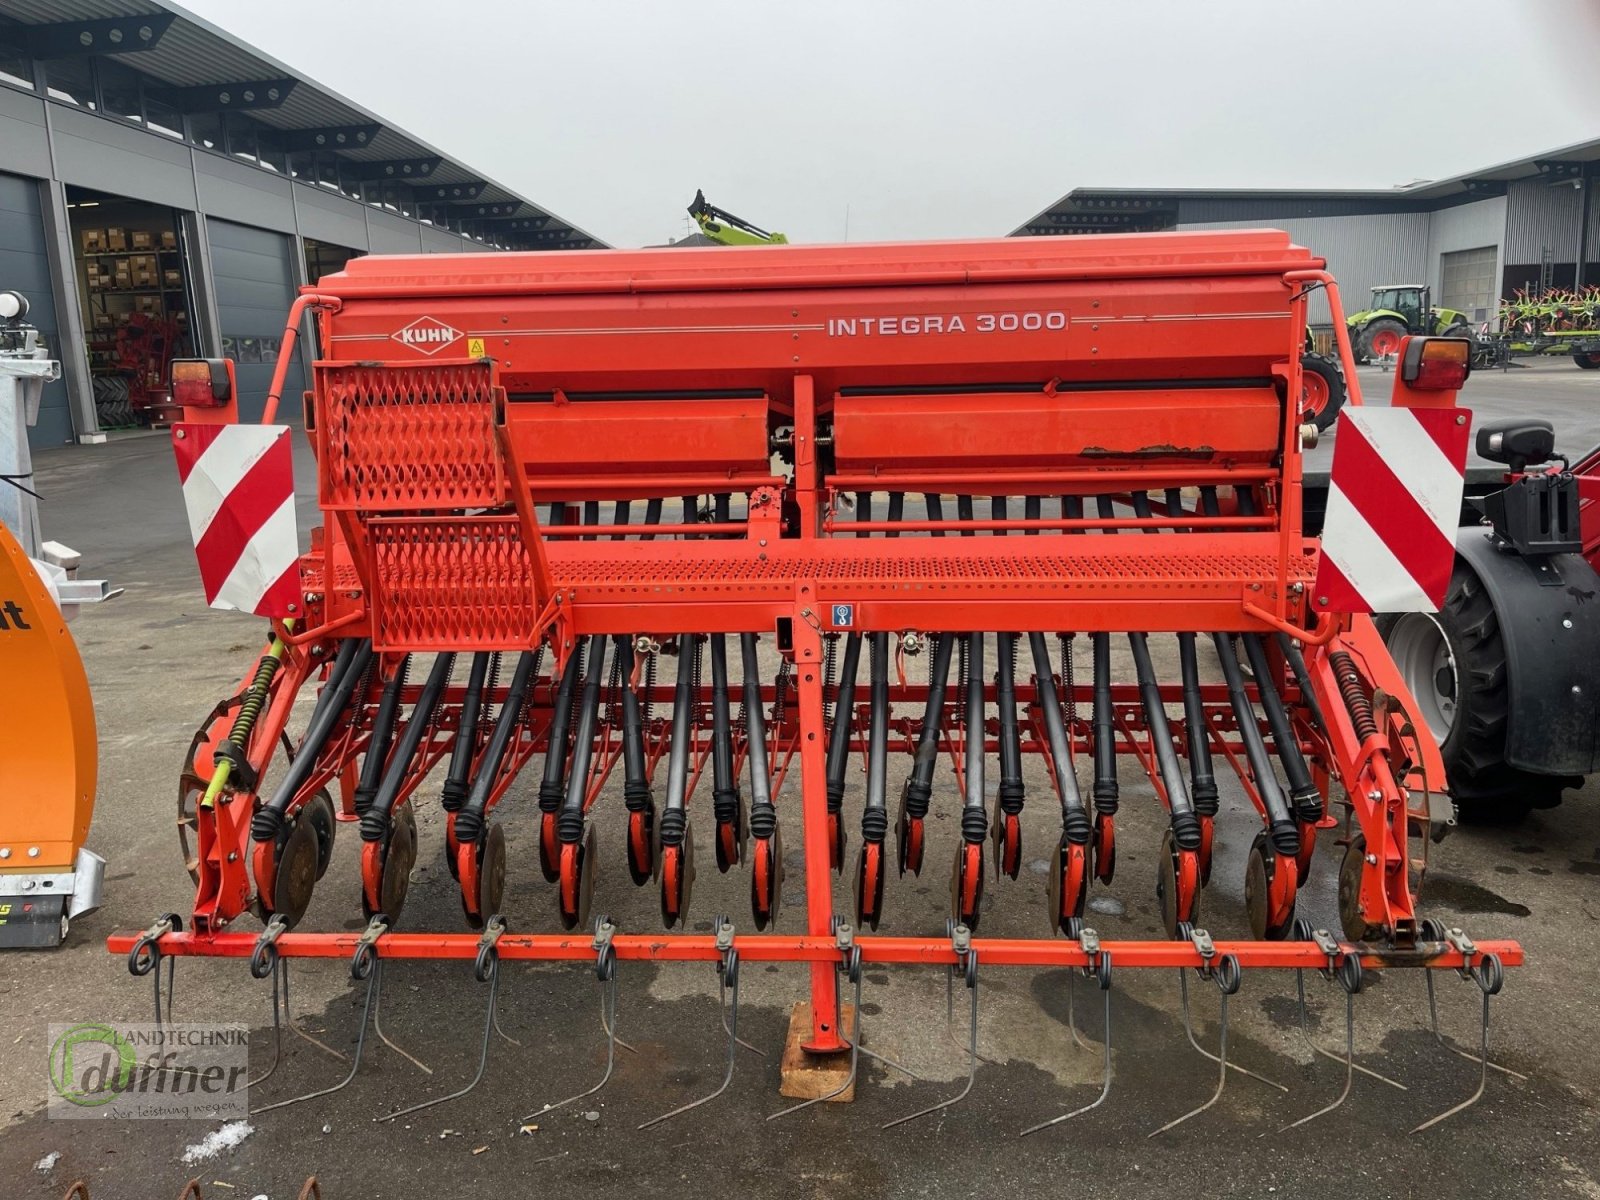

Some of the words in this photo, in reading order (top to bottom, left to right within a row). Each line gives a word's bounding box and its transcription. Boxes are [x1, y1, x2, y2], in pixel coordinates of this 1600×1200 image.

[828, 315, 966, 337] INTEGRA
[976, 312, 1066, 333] 3000
[401, 328, 454, 344] KUHN
